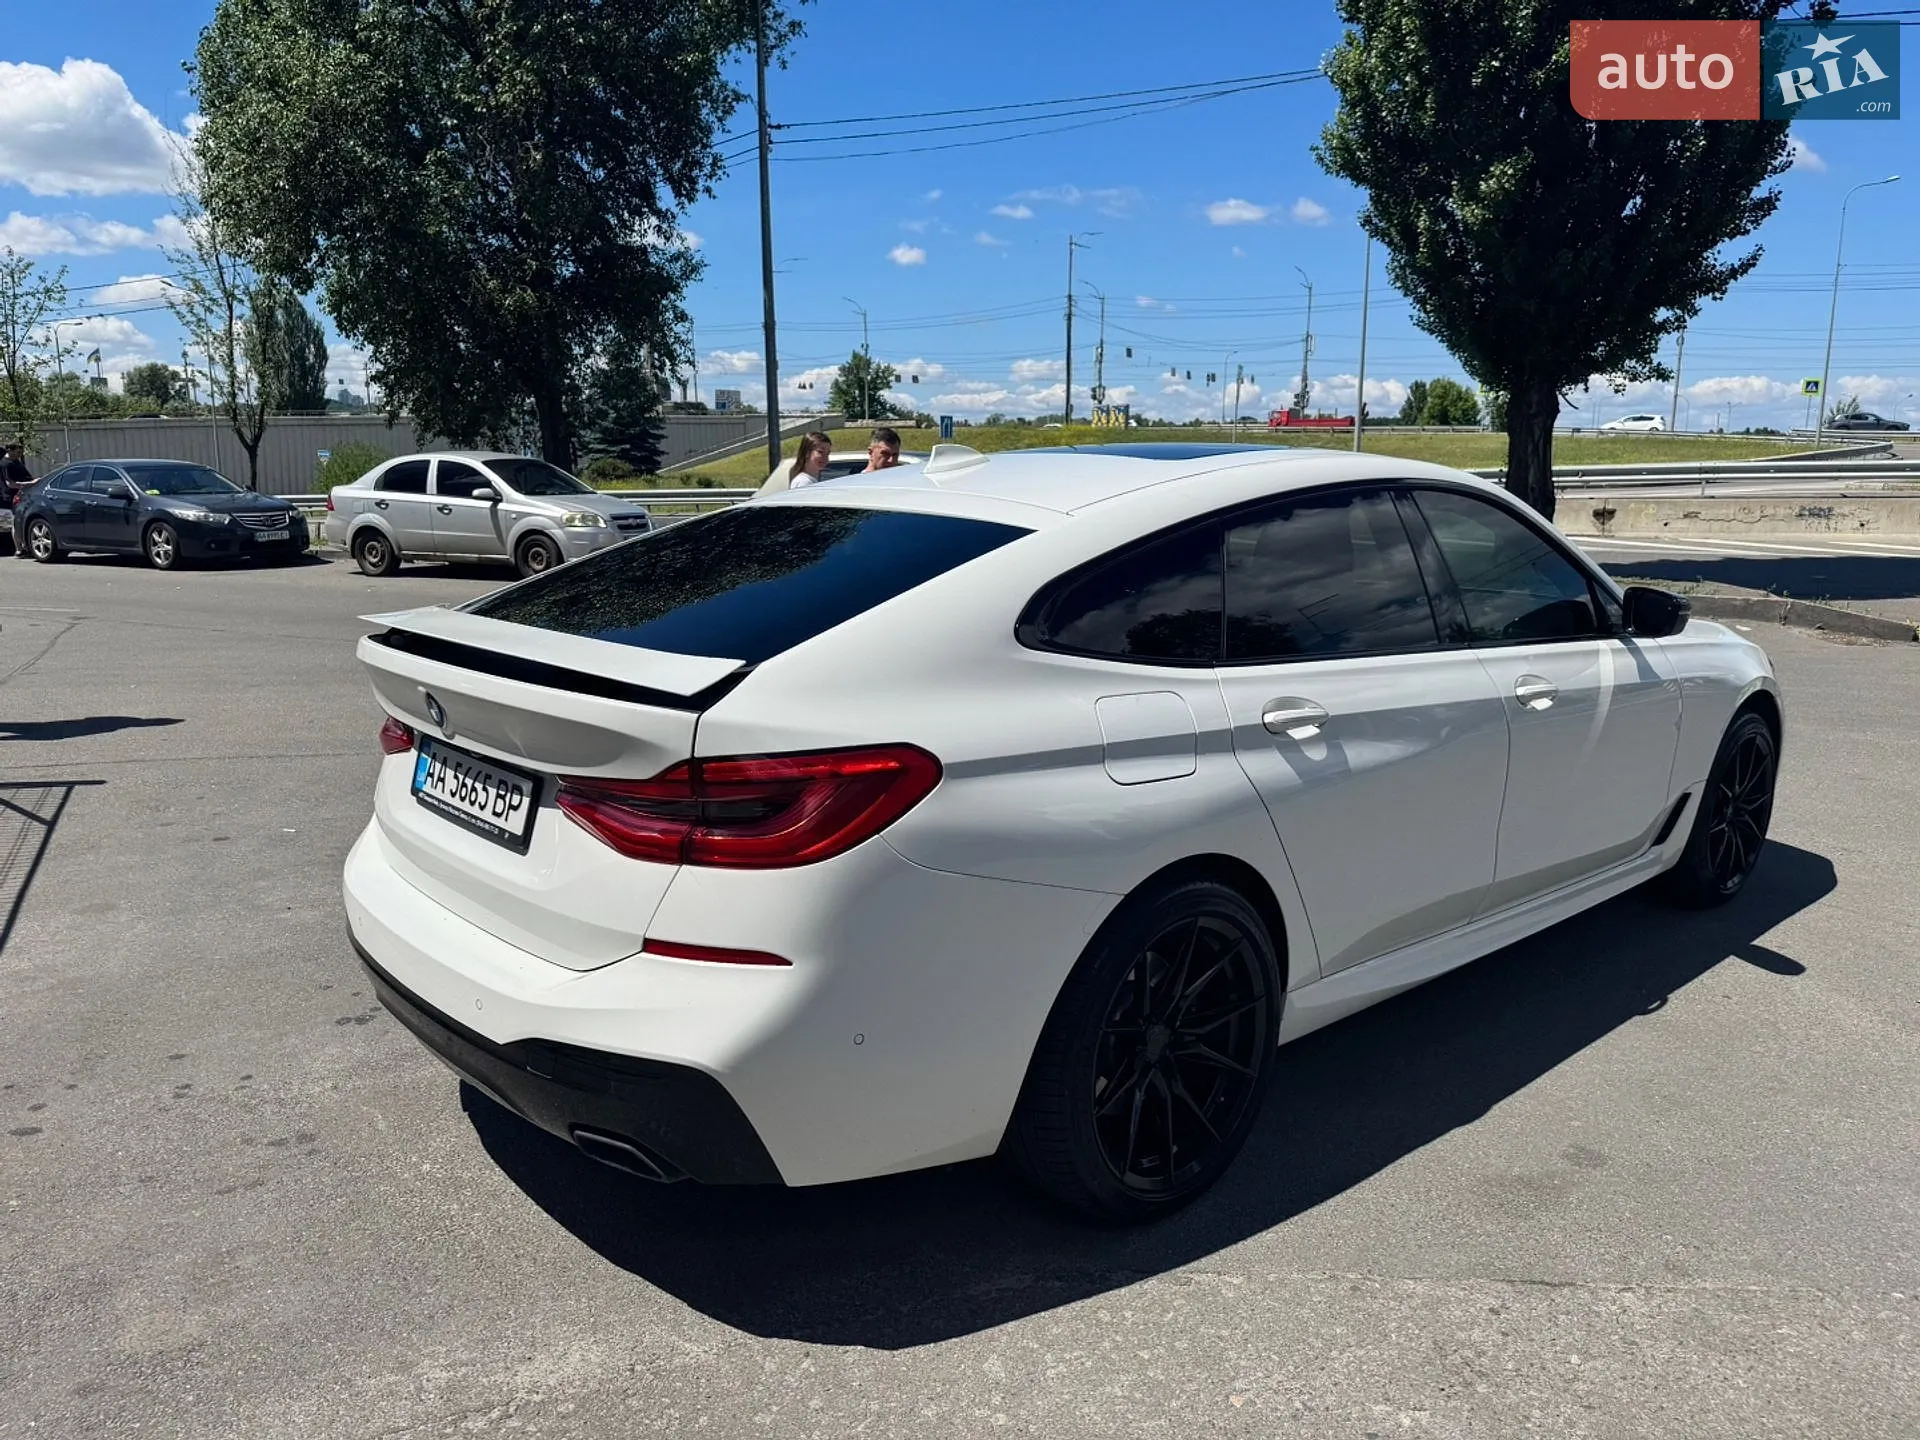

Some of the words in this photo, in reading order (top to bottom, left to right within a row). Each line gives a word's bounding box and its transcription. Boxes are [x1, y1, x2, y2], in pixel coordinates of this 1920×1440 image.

[426, 752, 448, 793] AA
[450, 761, 493, 811] 5665
[492, 778, 524, 822] BP
